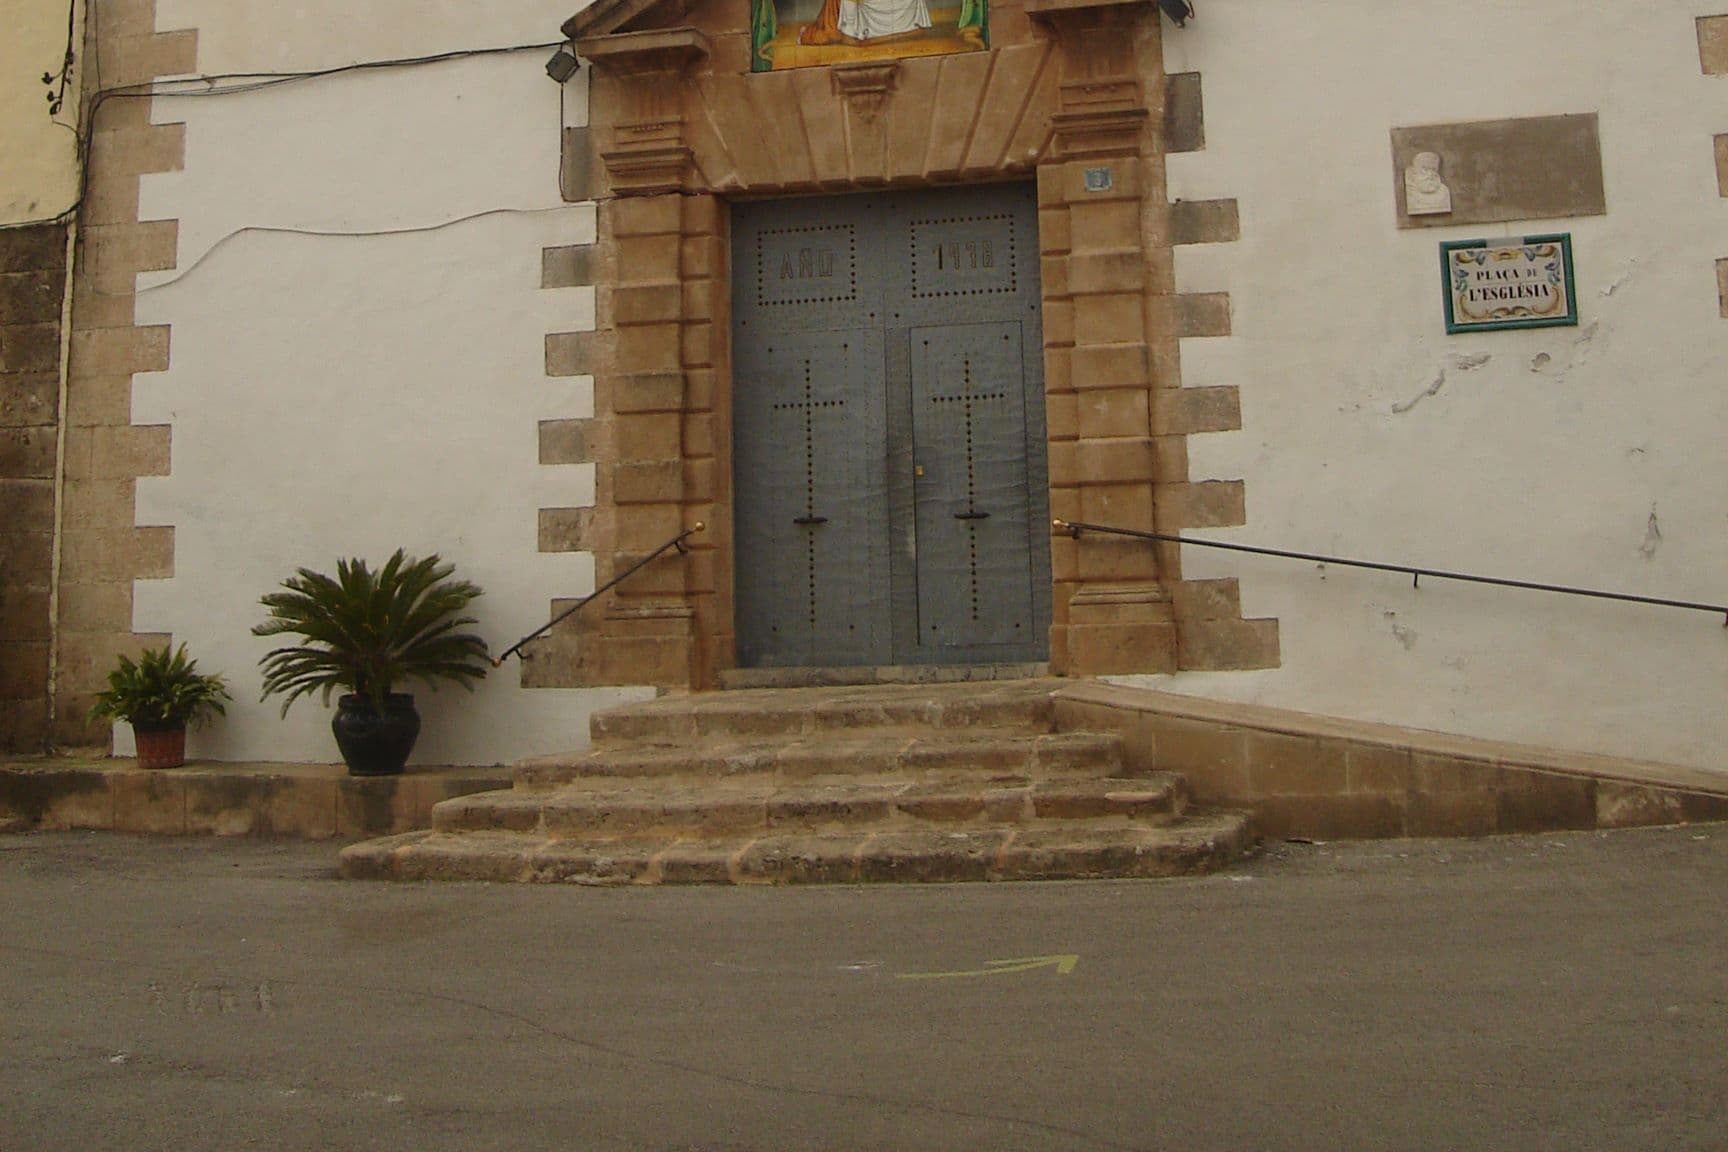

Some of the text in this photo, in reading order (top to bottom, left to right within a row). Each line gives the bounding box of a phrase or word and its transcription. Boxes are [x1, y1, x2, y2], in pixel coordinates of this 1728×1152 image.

[1476, 268, 1537, 281] PLAÇA DE
[1469, 282, 1549, 302] L'ESGLÉSIA
